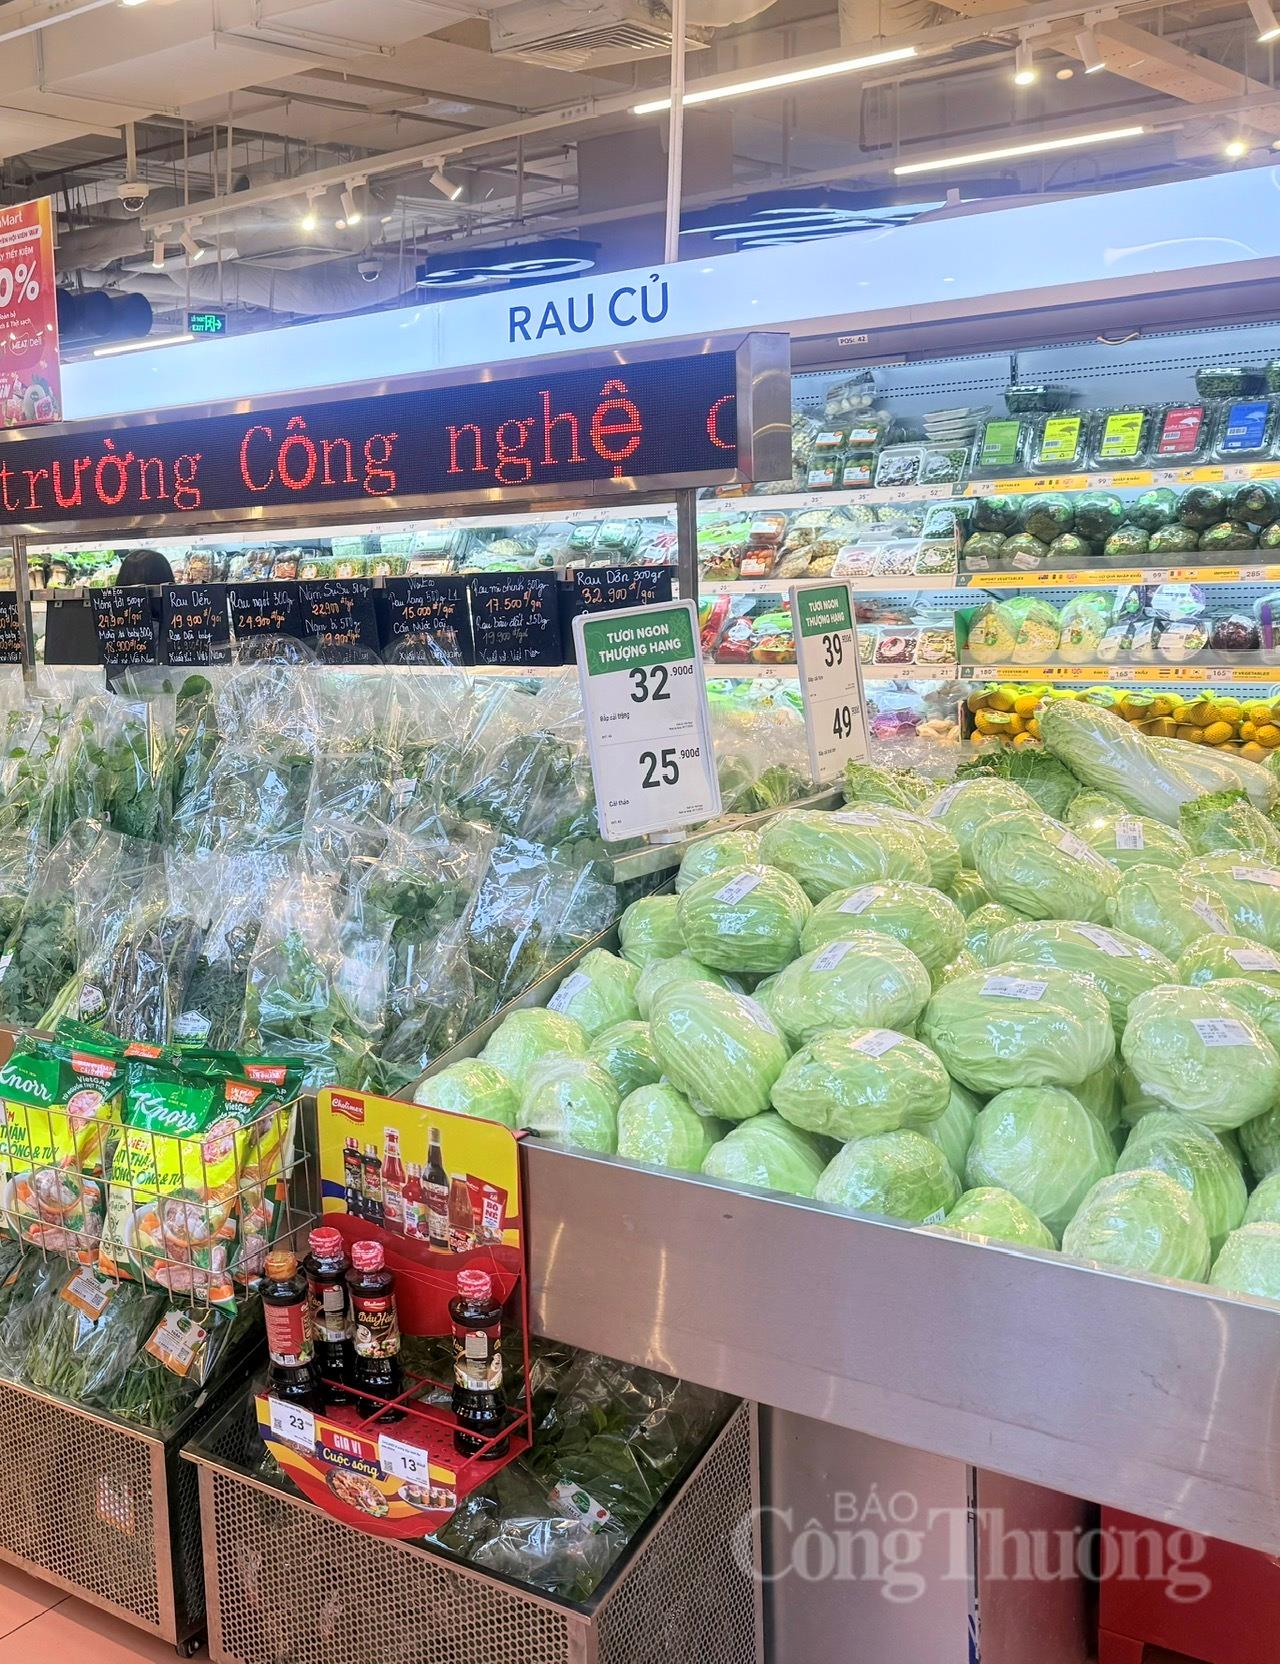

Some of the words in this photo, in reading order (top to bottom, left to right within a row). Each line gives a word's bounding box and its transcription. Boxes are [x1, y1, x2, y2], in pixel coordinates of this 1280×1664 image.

[6, 249, 19, 259] TIẾT
[19, 246, 34, 257] KIỆM
[508, 292, 595, 343] RAU
[608, 272, 670, 328] CỦ
[240, 415, 399, 497] Công
[446, 379, 643, 485] nghệ
[576, 571, 601, 586] Rau
[170, 591, 188, 607] Rau
[808, 602, 822, 613] TƯƠI
[822, 598, 839, 610] NGON
[806, 615, 829, 628] THƯỢNG
[829, 612, 845, 623] HẠNG
[607, 629, 634, 643] TƯƠI
[637, 624, 669, 639] NGON
[599, 644, 647, 663] THƯỢNG
[649, 638, 681, 654] HẠNG
[0, 1065, 53, 1102] Knorr
[77, 1076, 111, 1087] VietGAP
[130, 1088, 198, 1131] Knorr
[333, 1434, 350, 1451] GIA
[351, 1438, 362, 1458] VỊ
[323, 1447, 350, 1468] Cuộc
[352, 1457, 379, 1481] sống
